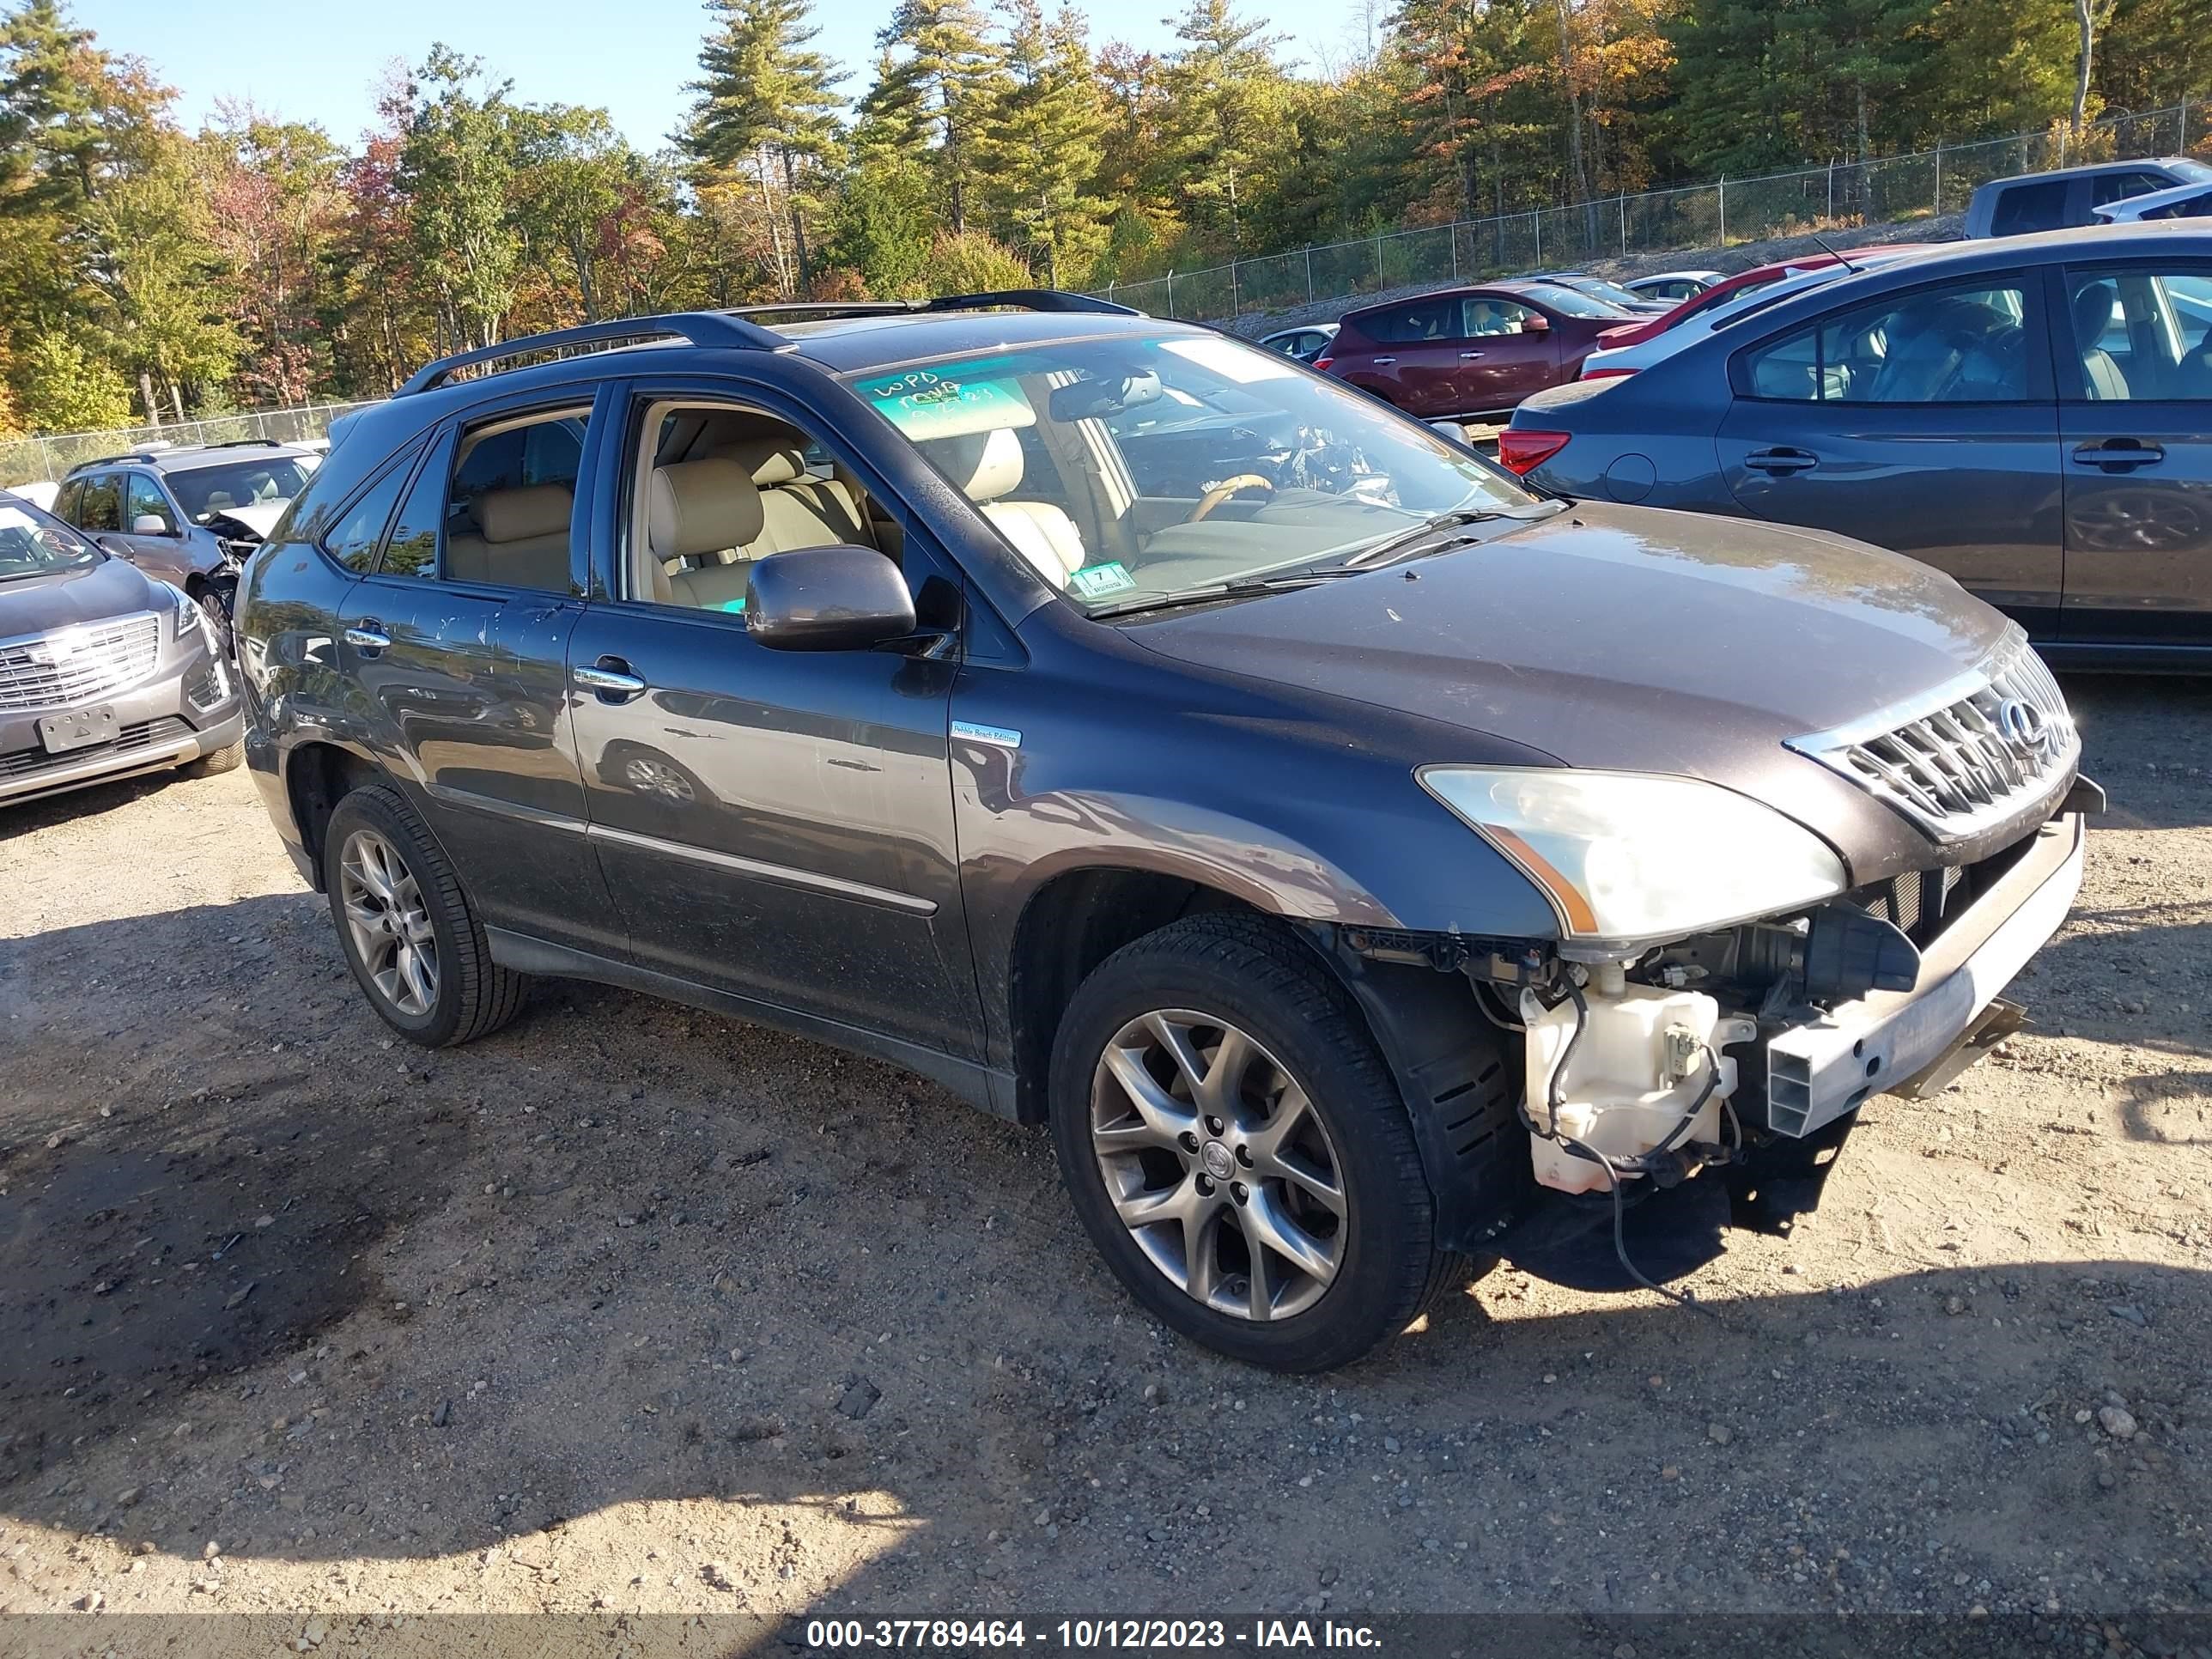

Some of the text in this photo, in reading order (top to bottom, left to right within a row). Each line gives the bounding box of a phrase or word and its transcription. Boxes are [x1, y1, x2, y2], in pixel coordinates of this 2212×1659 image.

[874, 372, 939, 397] WPD
[1094, 572, 1103, 581] 7
[953, 726, 1017, 743] Pebble Beach Edition
